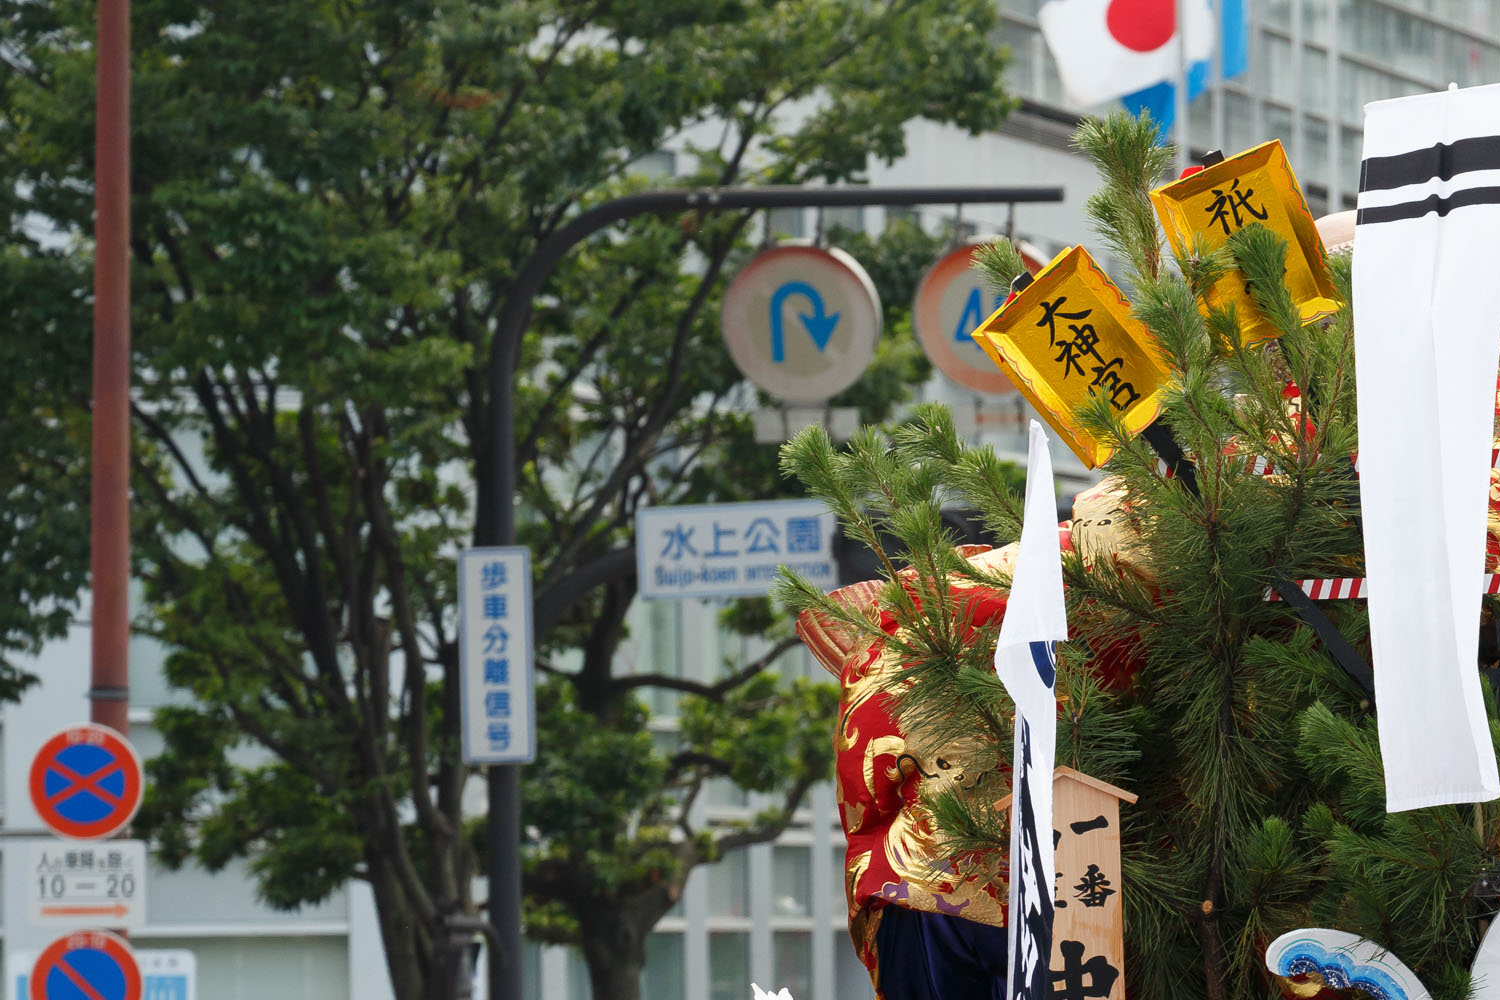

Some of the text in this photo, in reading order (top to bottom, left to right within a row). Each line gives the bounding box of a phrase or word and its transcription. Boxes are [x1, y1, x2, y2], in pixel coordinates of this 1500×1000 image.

[955, 287, 1006, 346] 4
[1036, 296, 1141, 411] 大神宮
[660, 517, 821, 561] 水上公園
[480, 561, 512, 752] 歩車分離信号
[1069, 814, 1117, 909] 一番
